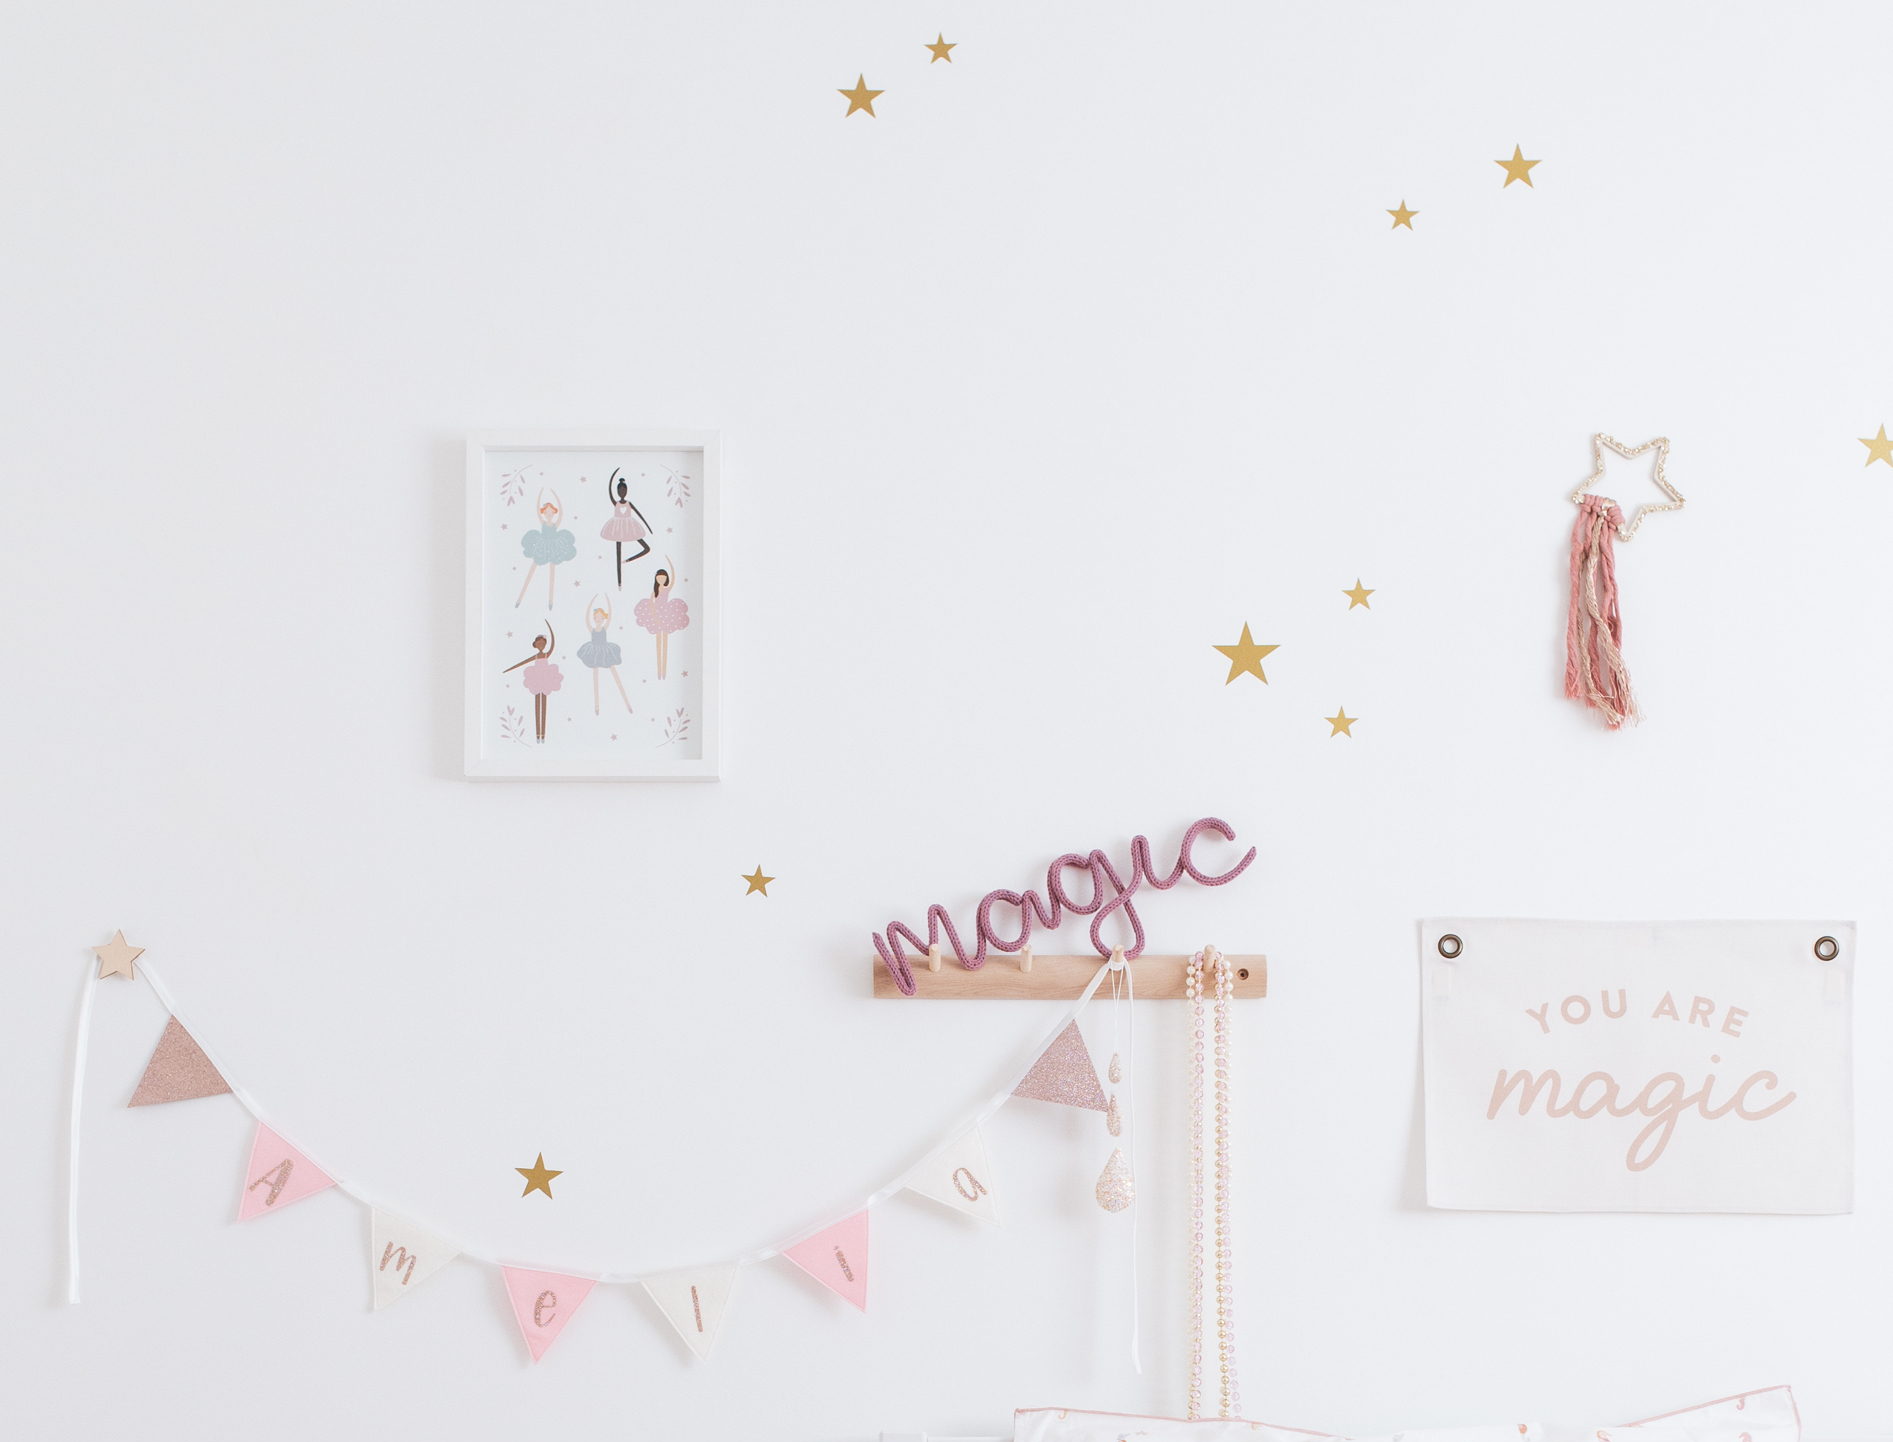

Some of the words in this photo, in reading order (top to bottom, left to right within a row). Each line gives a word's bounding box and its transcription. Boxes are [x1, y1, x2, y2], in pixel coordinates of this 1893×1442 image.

[872, 816, 1257, 996] magic
[1525, 988, 1628, 1035] YOU
[1651, 990, 1750, 1039] ARE
[1486, 1054, 1798, 1172] magic
